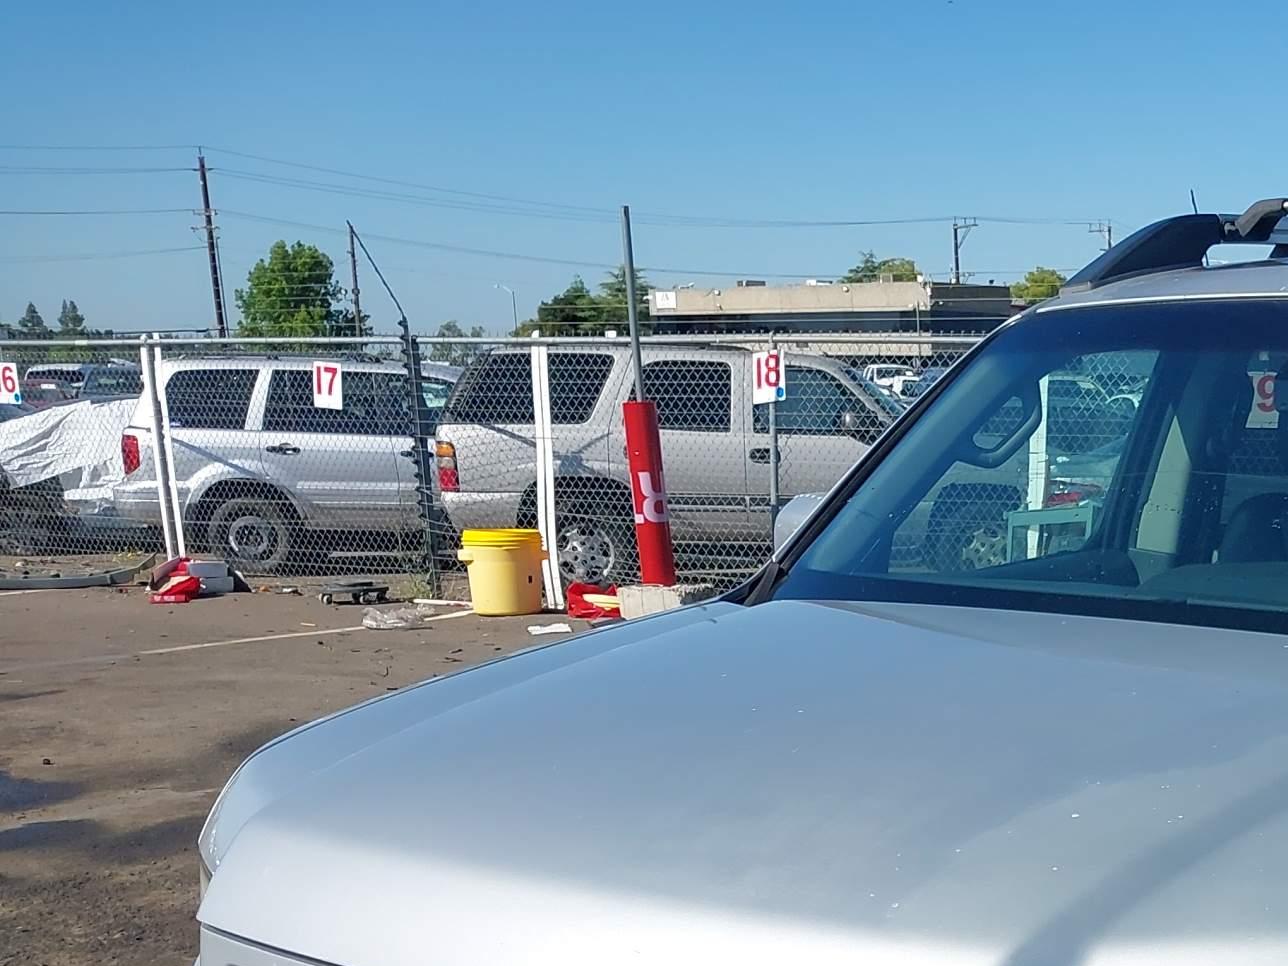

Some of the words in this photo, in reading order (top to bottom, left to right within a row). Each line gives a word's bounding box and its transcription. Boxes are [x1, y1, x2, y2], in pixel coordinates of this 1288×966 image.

[0, 366, 16, 393] 6
[316, 366, 337, 396] 17
[757, 355, 780, 389] 18
